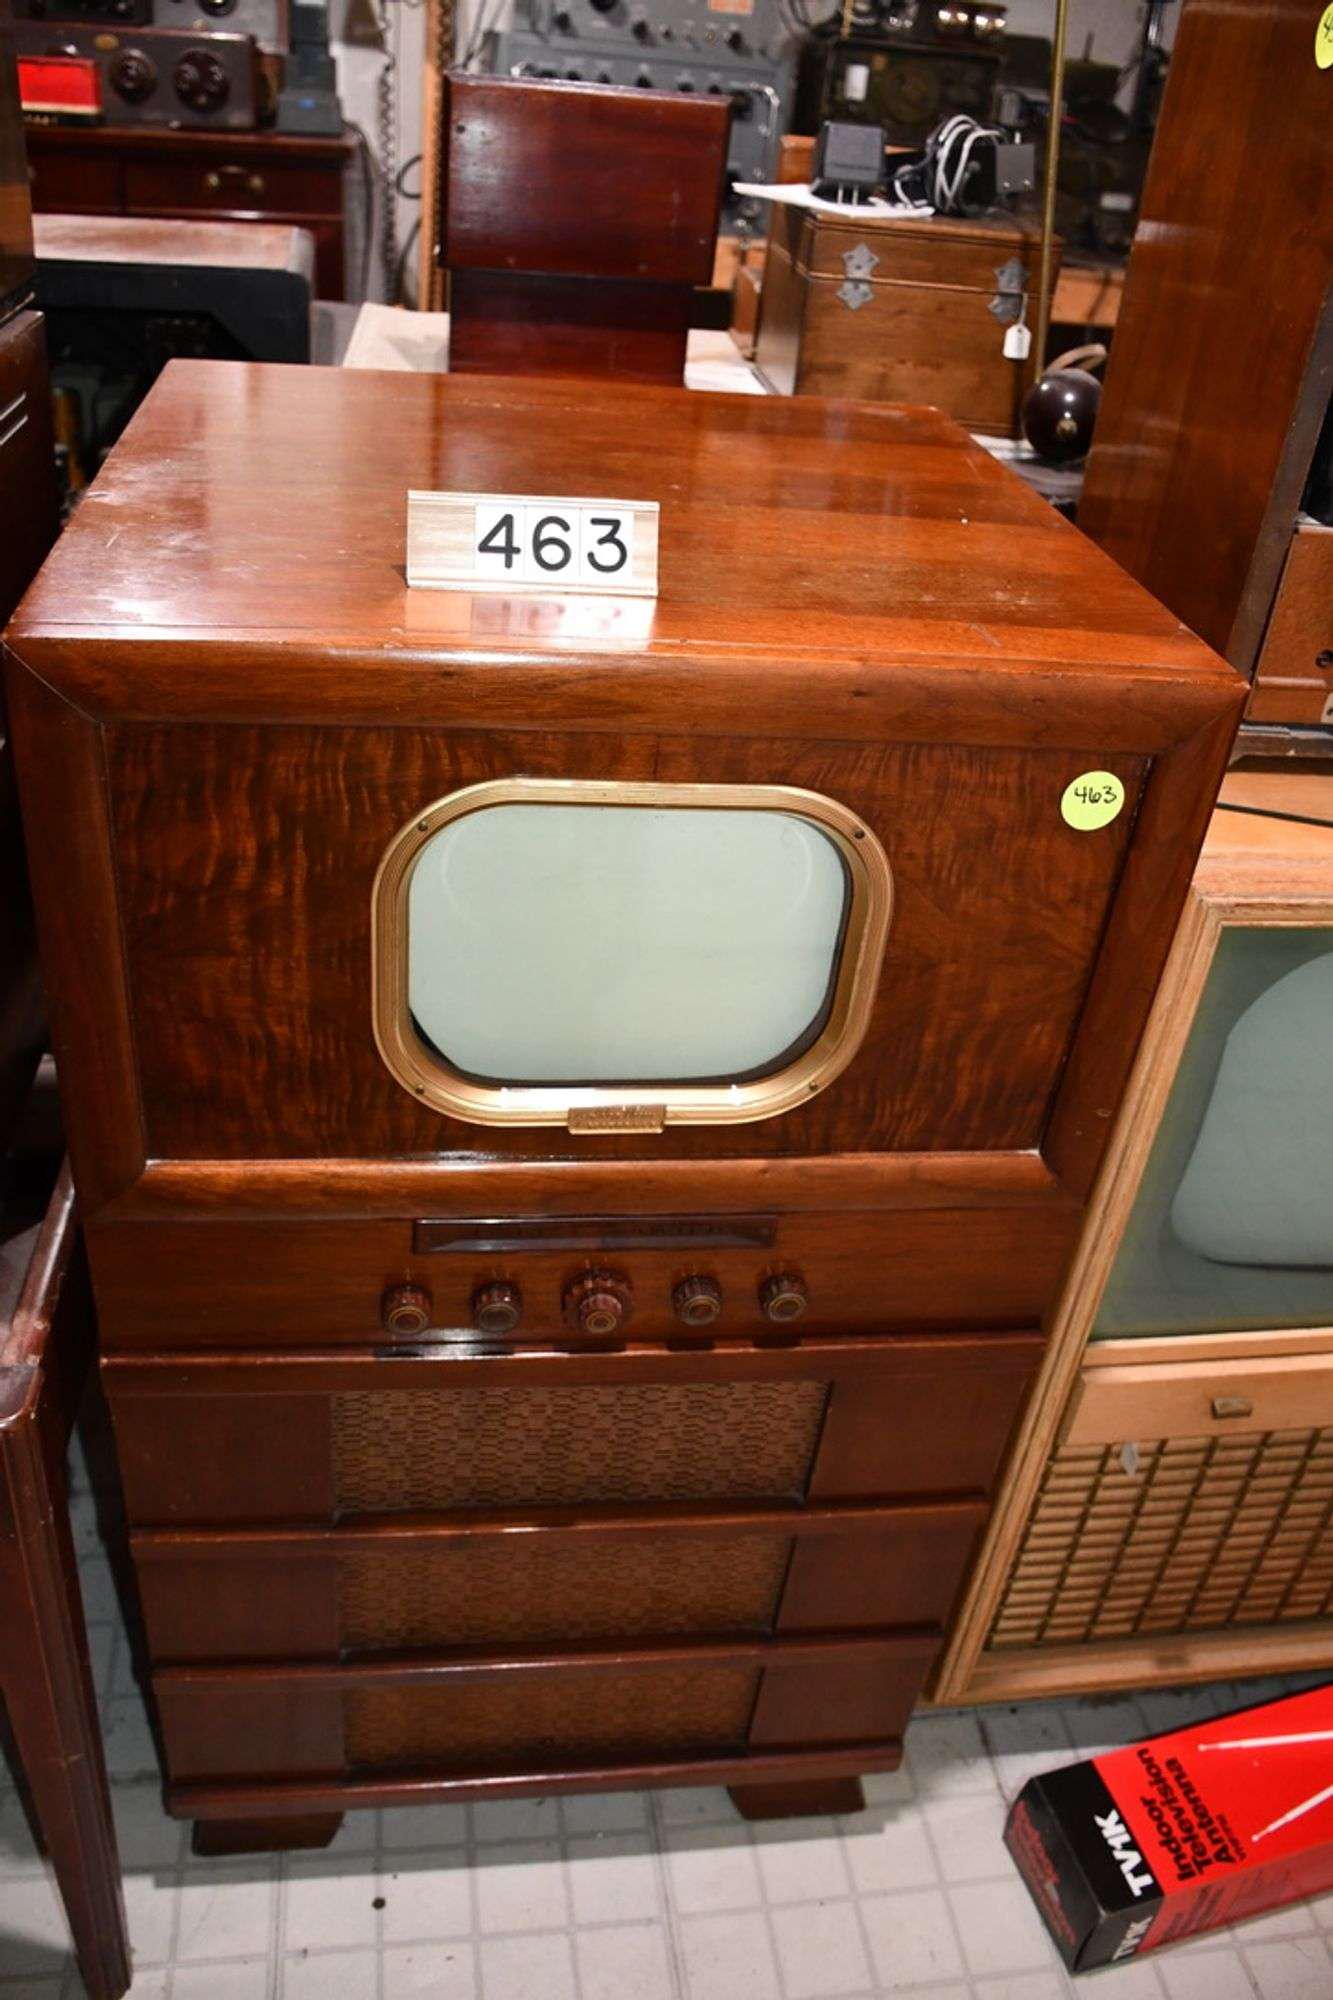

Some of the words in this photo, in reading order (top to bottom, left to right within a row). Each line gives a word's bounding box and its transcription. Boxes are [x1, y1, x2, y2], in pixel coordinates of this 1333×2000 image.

[478, 513, 628, 573] 463
[1074, 785, 1117, 804] 463
[1138, 1749, 1213, 1873] Television
[1140, 1796, 1195, 1880] Indoor
[1167, 1758, 1234, 1863] Antenna
